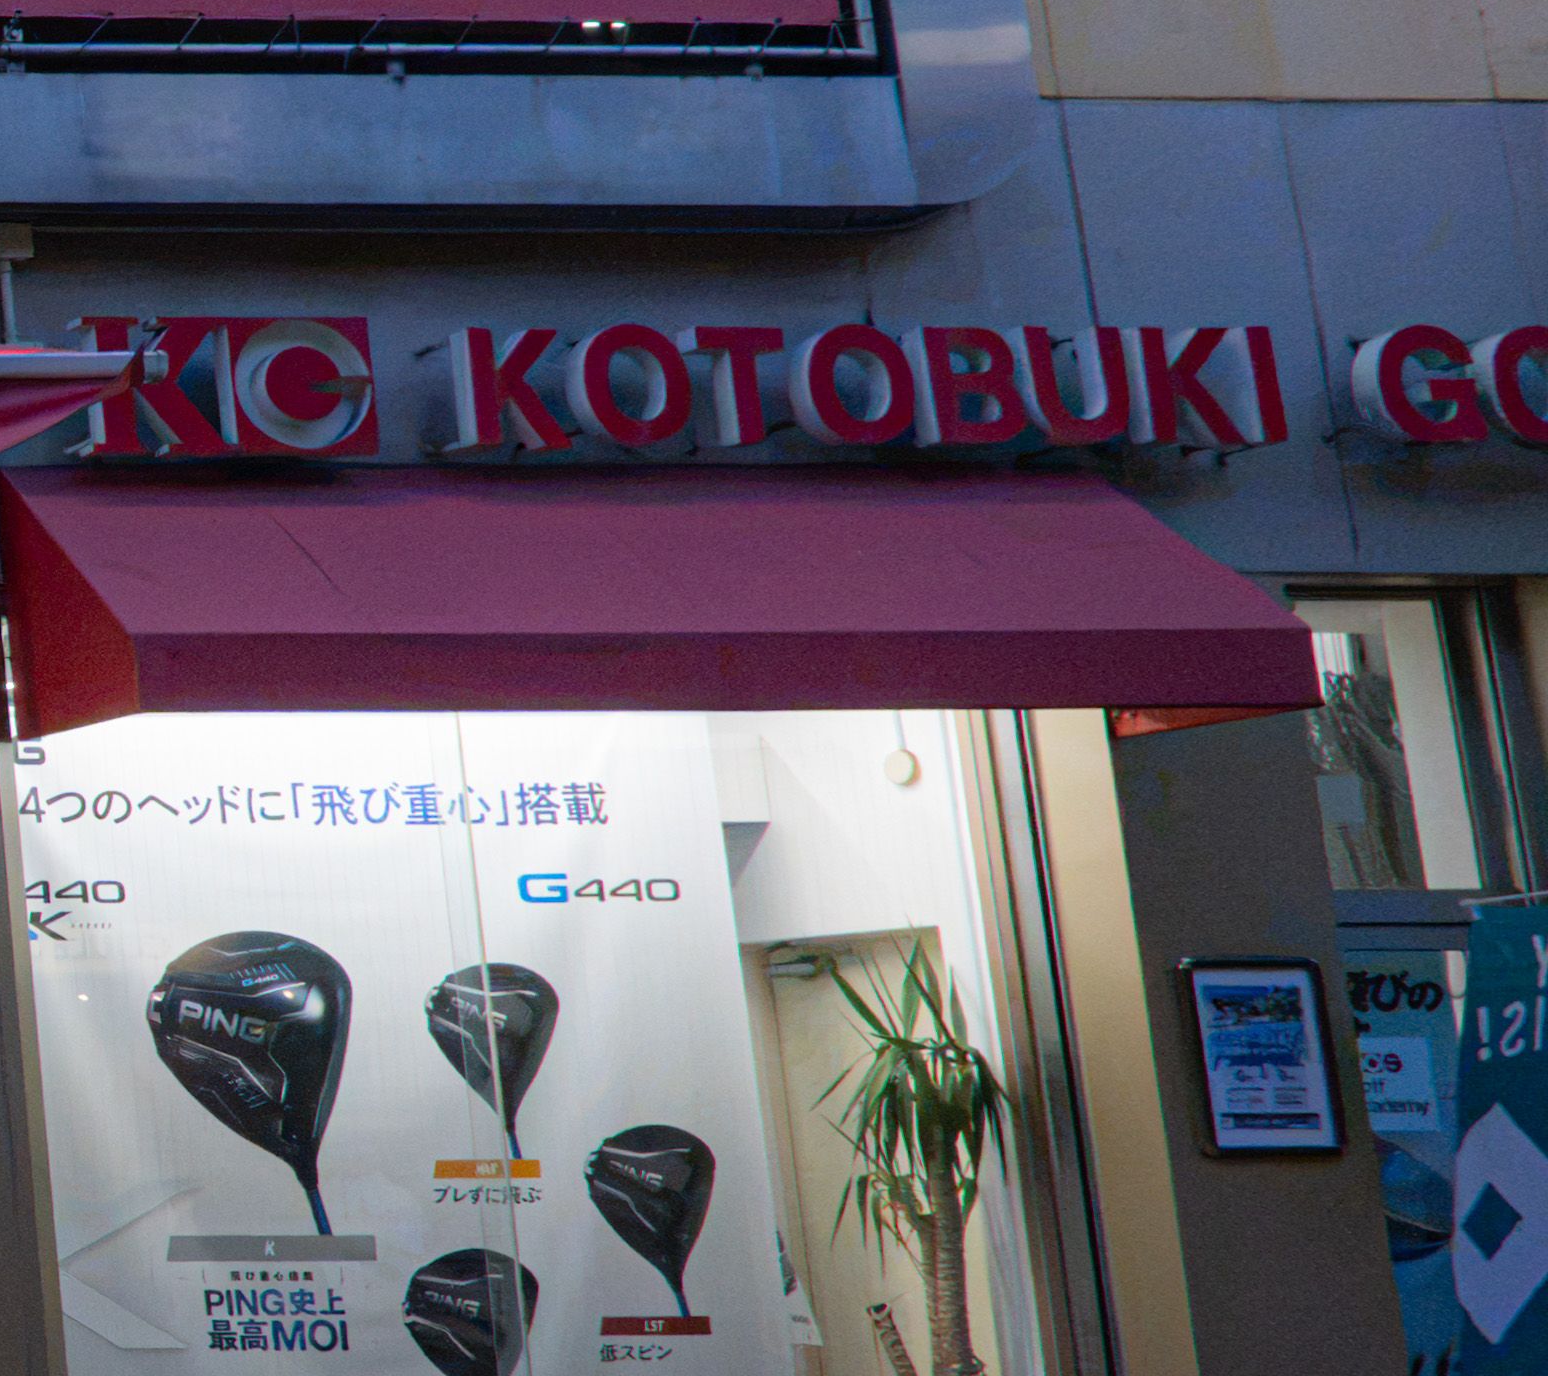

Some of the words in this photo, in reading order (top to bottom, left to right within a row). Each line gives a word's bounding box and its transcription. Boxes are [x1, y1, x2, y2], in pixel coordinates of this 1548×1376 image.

[448, 323, 1288, 451] KOTOBUKI
[17, 781, 610, 827] 4つのヘッドに「飛び重心」搭載
[516, 872, 682, 905] G440
[177, 999, 271, 1044] PING
[203, 1288, 346, 1317] PING史上
[207, 1318, 350, 1352] 最高MOI
[644, 1320, 664, 1332] LST
[599, 1343, 673, 1362] 低スピン
